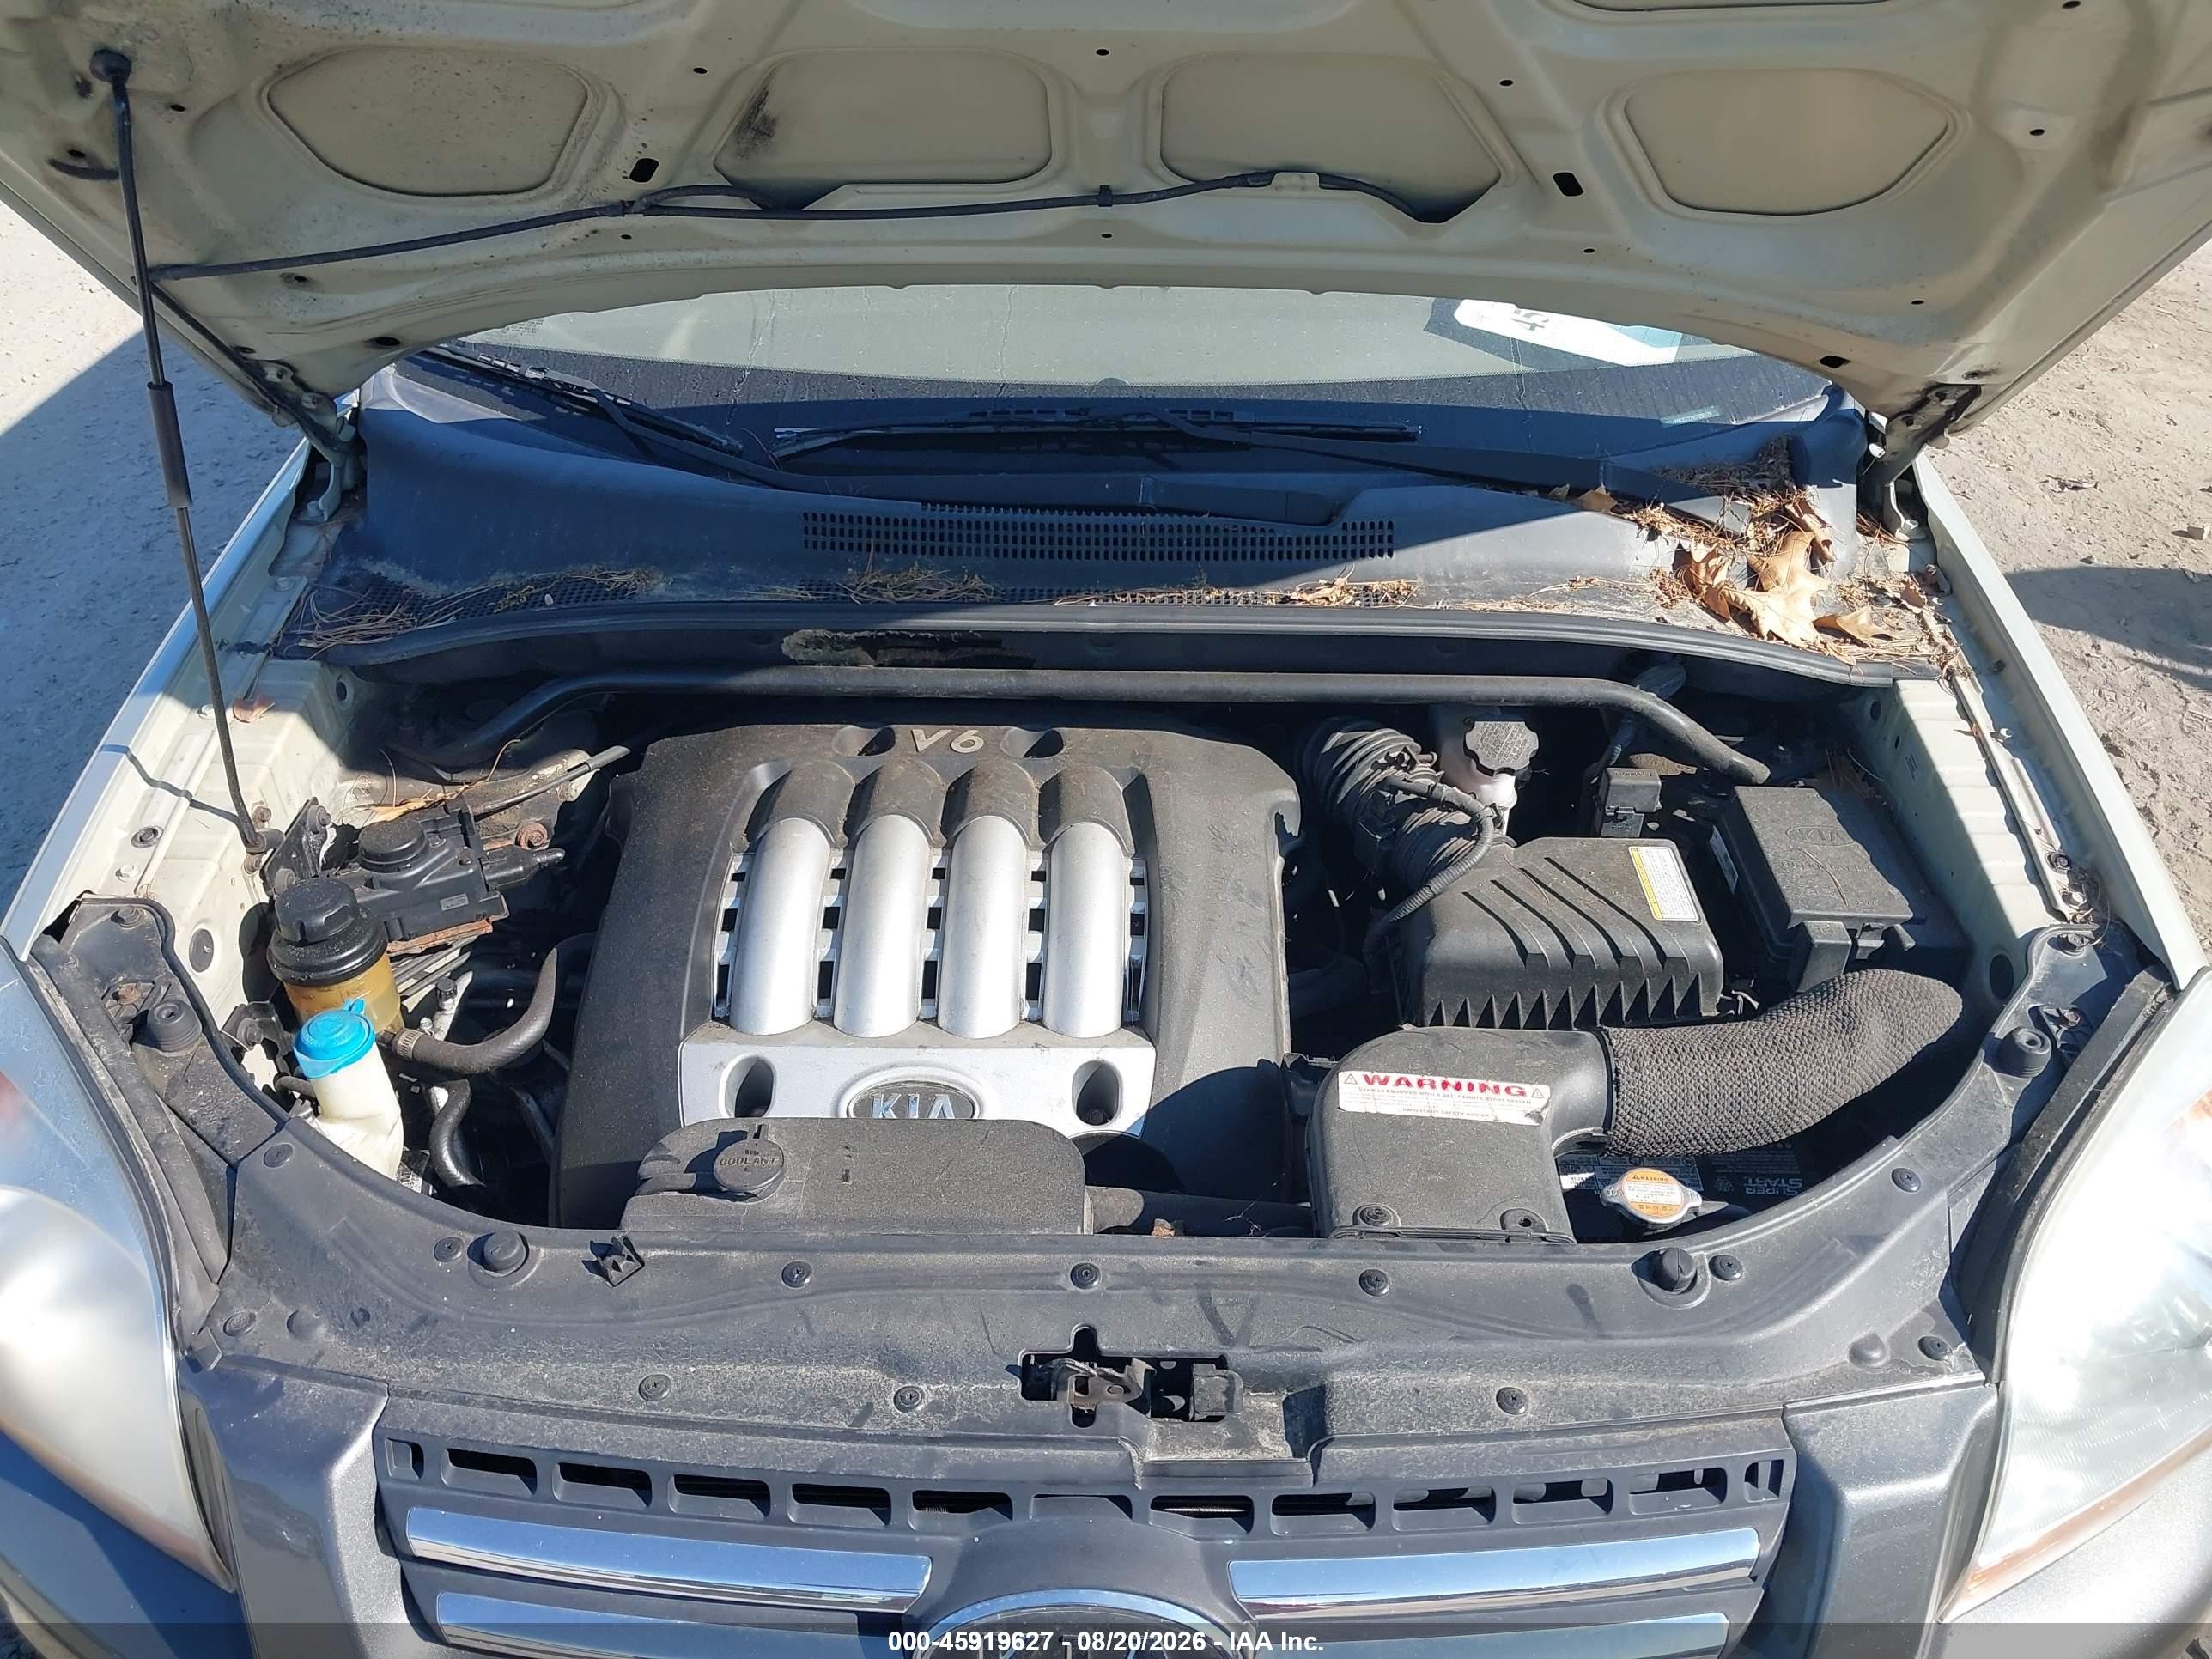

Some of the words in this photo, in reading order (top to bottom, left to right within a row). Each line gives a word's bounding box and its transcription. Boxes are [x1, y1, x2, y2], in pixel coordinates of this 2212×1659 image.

[911, 728, 985, 754] V6
[1362, 1073, 1527, 1097] WARNING
[872, 1092, 955, 1119] KIA
[719, 1156, 779, 1167] COOLANT
[1745, 1186, 1799, 1195] SUPER
